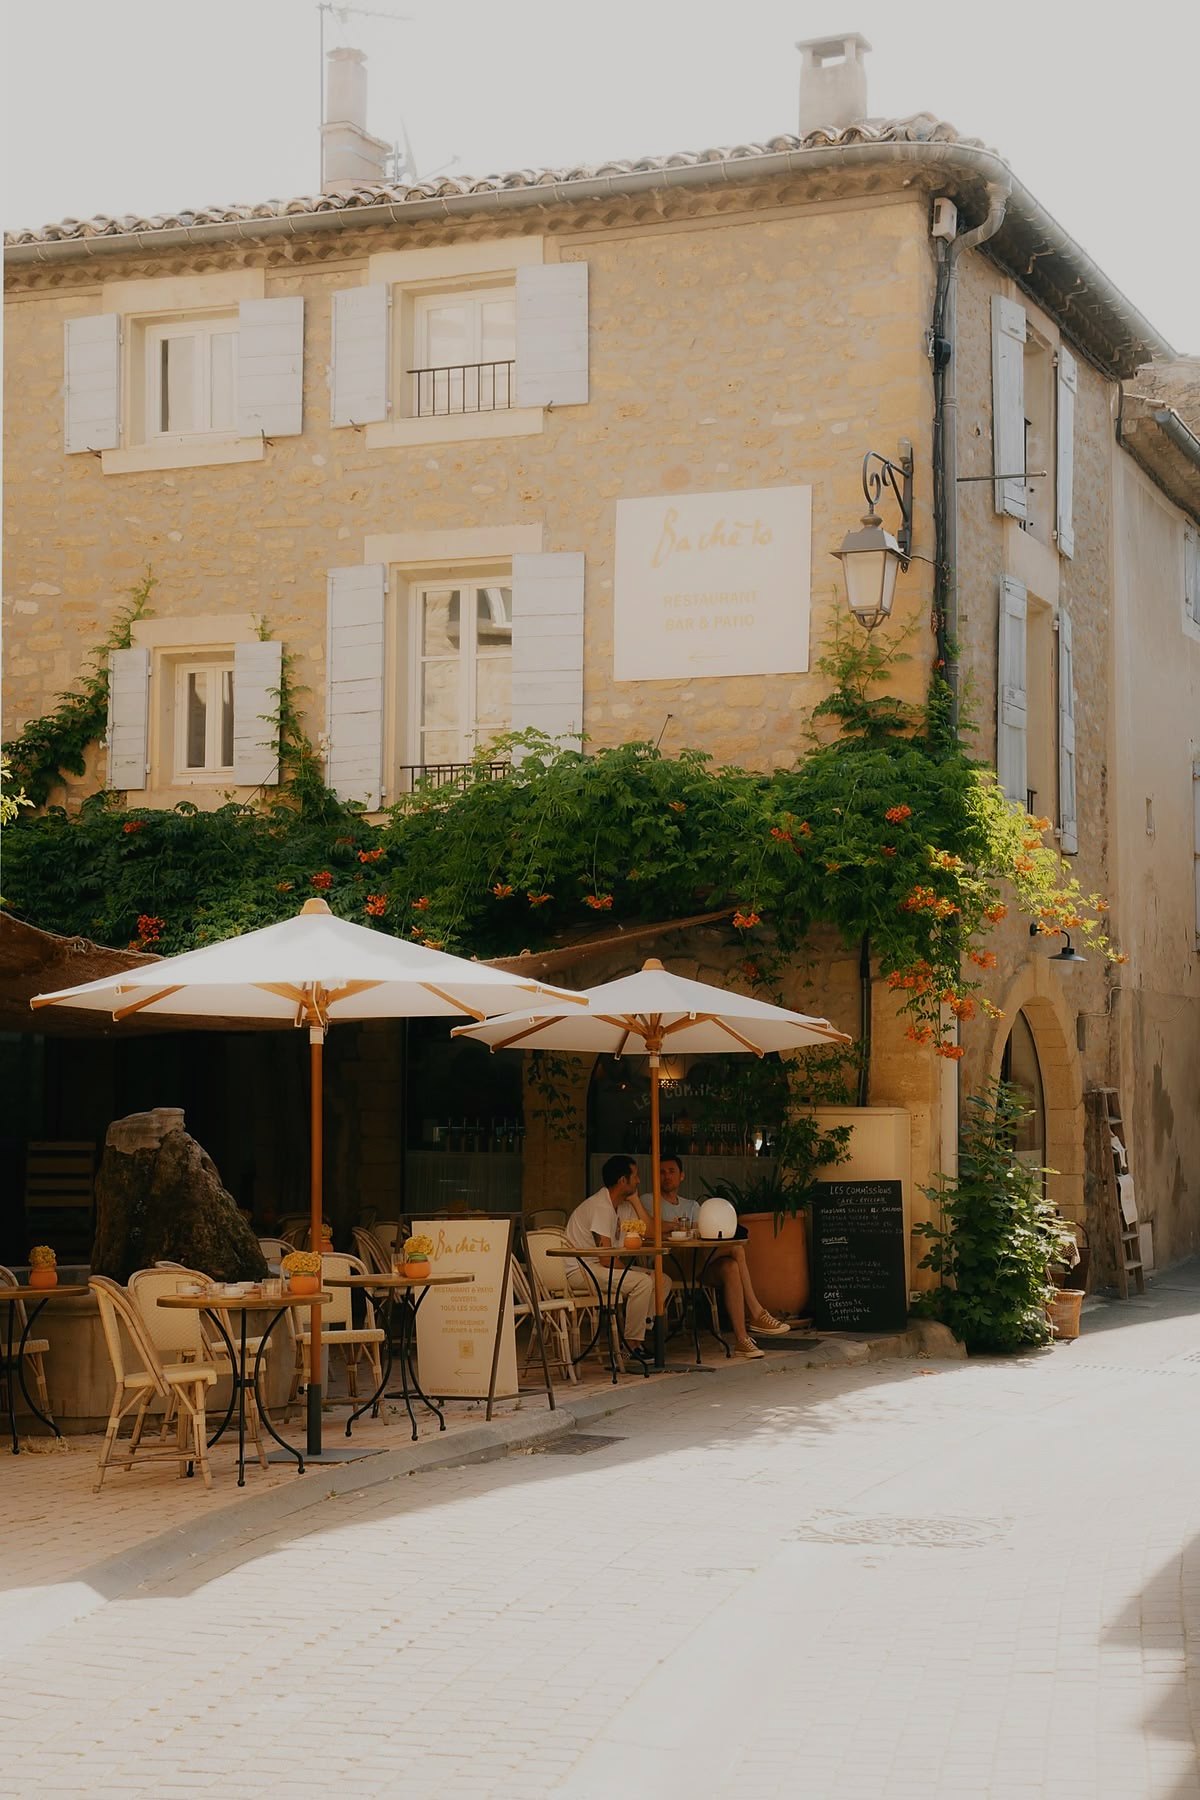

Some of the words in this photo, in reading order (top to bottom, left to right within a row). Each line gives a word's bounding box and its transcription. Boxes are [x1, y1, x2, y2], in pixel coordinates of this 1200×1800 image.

[663, 591, 759, 608] RESTAURANT
[664, 616, 694, 632] BAR
[714, 614, 755, 630] PATIO
[830, 1185, 844, 1195] LES
[846, 1185, 892, 1195] COMMISSIONS
